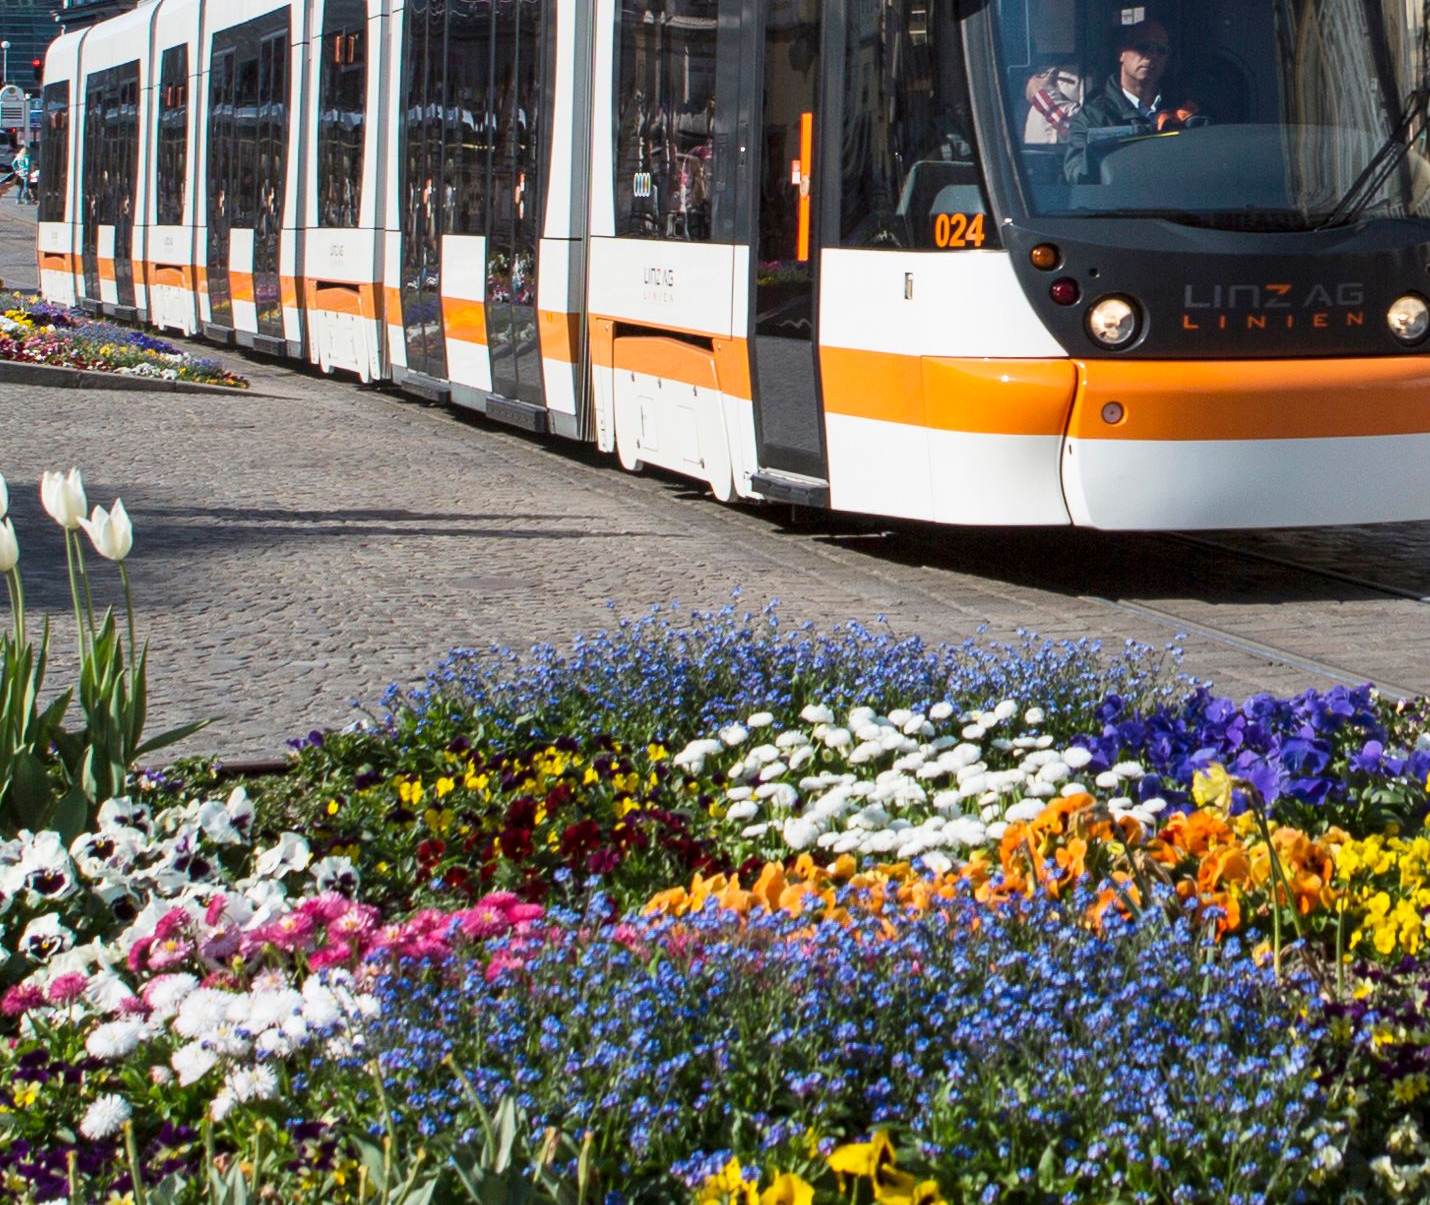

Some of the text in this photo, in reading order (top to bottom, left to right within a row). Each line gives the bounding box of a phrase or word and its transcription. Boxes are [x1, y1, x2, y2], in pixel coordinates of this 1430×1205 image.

[935, 212, 985, 248] 024
[1184, 283, 1363, 308] LINZ AG
[1183, 313, 1363, 329] LINIEN
